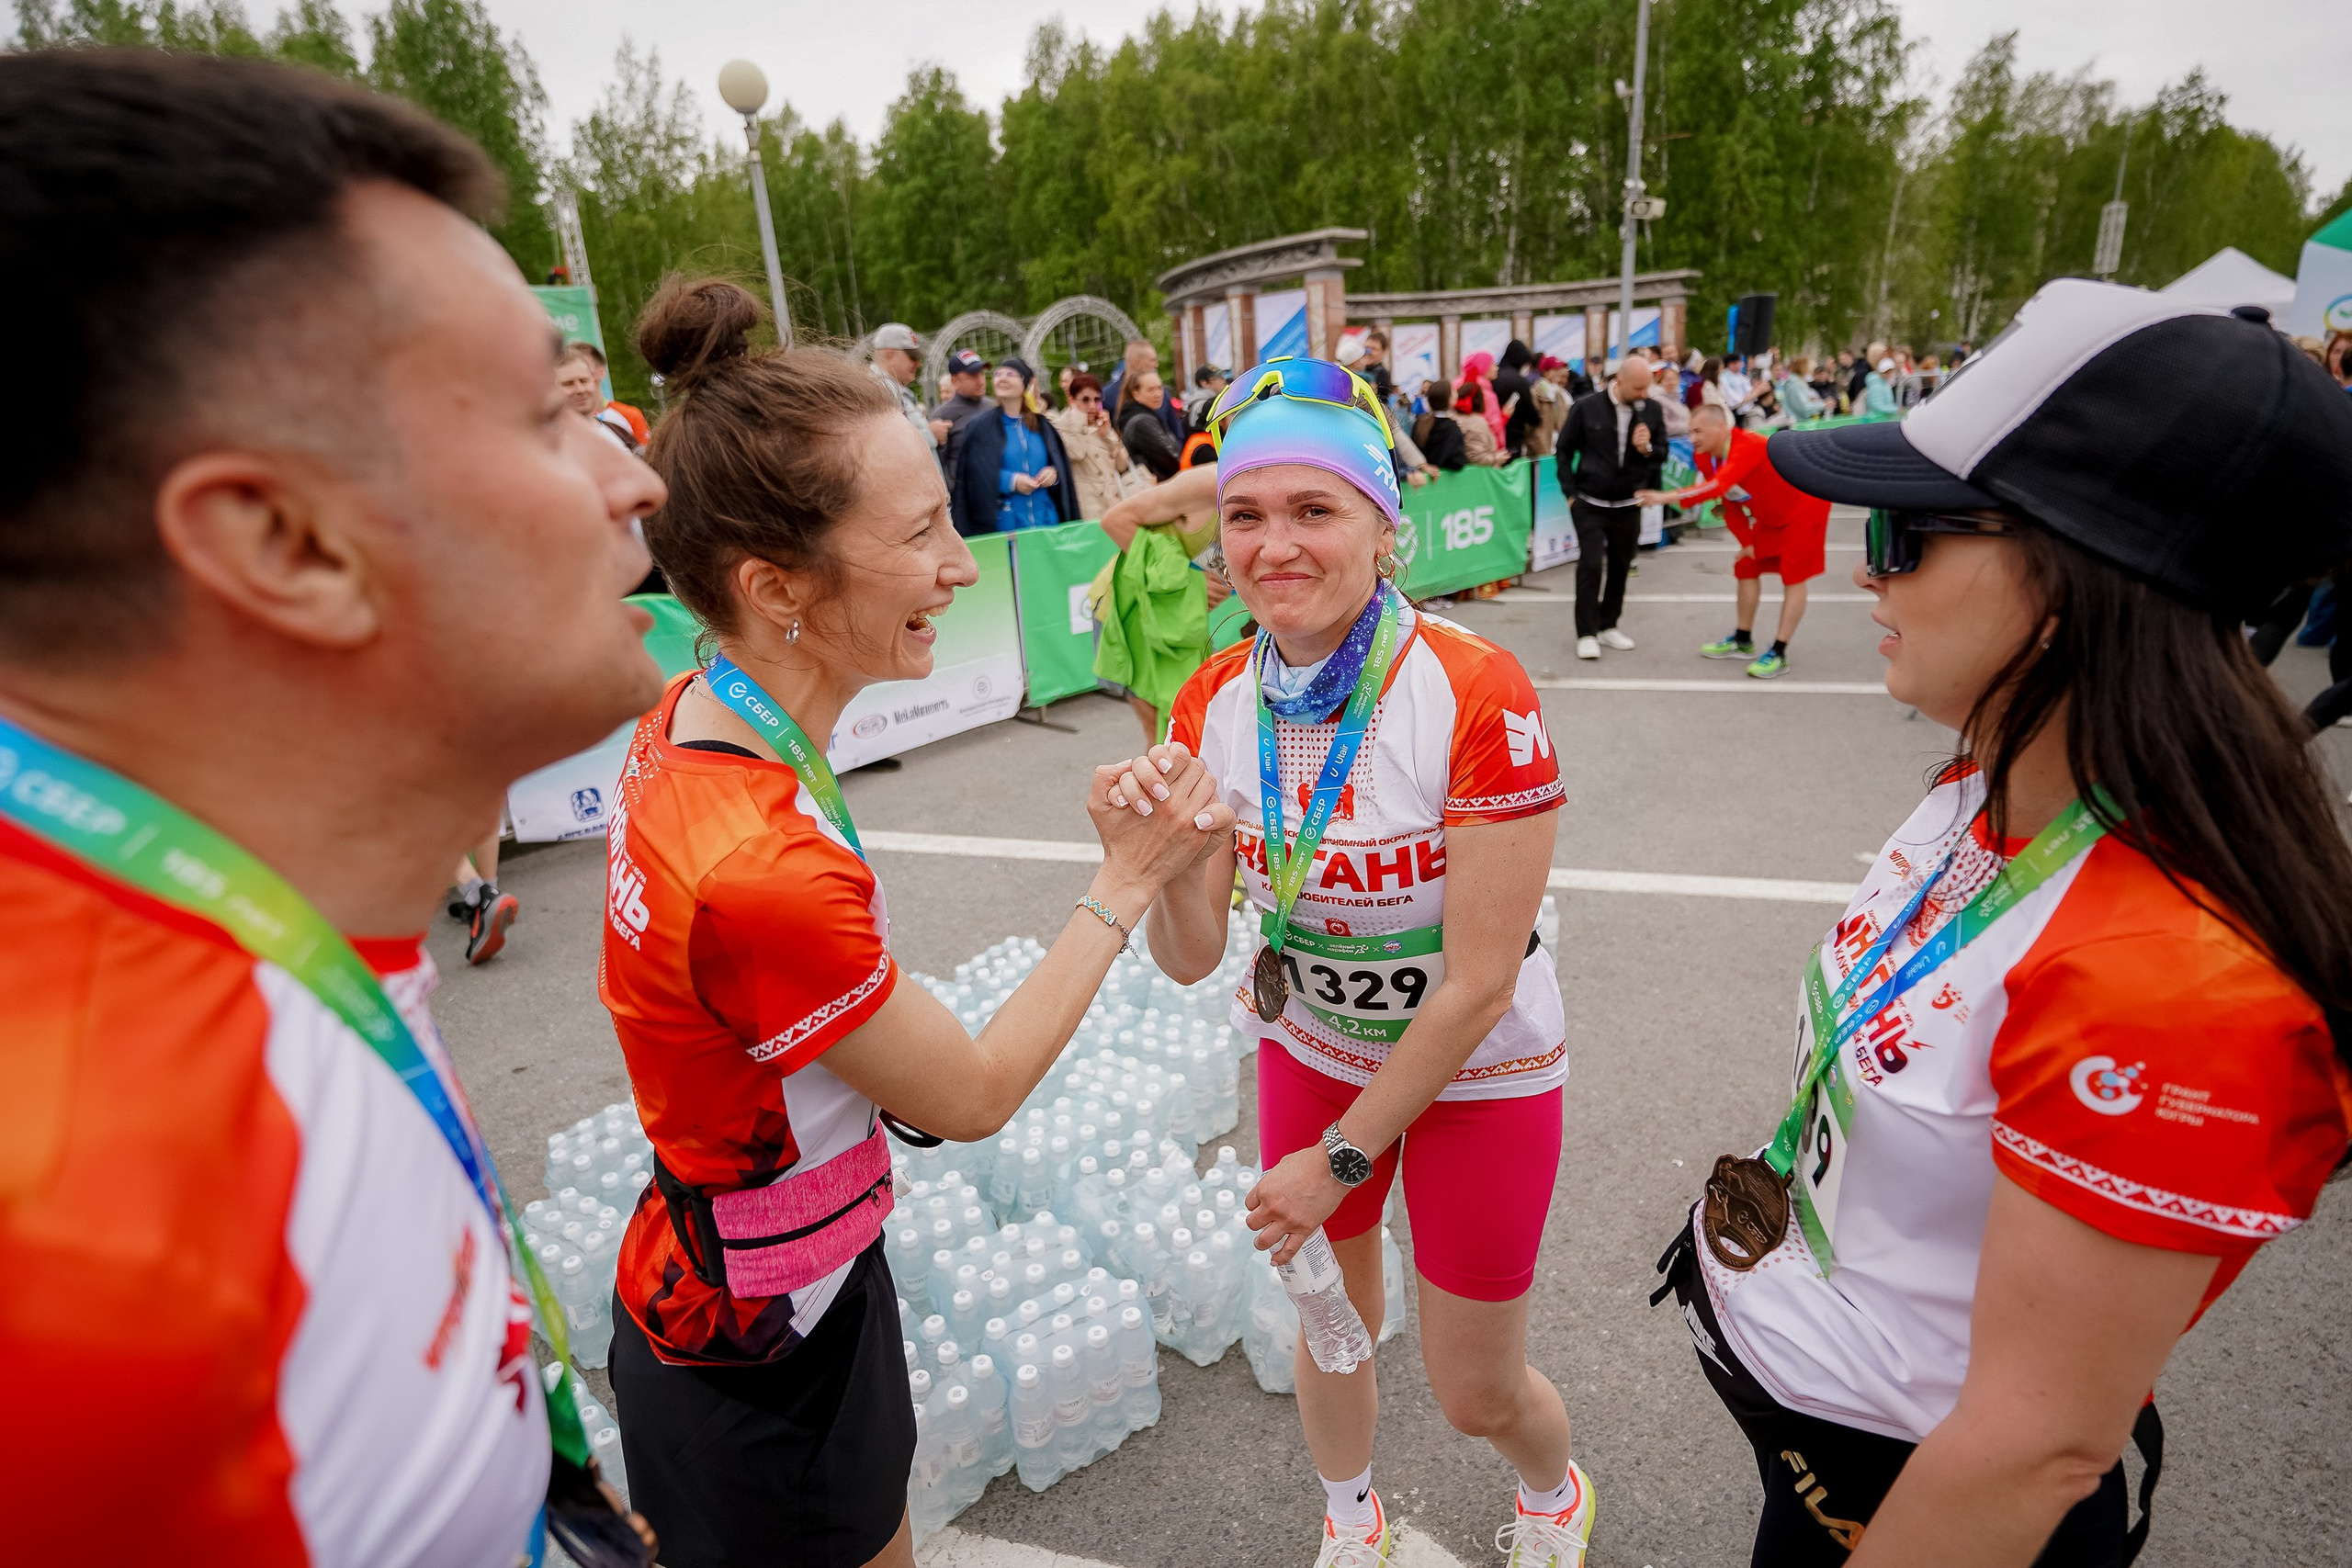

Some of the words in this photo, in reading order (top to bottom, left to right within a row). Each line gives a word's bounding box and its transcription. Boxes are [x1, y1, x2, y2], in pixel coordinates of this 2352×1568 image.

[1441, 506, 1494, 551] 185
[1374, 649, 1385, 669] 185
[744, 696, 779, 728] СБЕР
[786, 739, 807, 762] 185
[803, 763, 818, 783] лет
[1335, 744, 1349, 764] Utair
[1269, 811, 1278, 840] СБЕР
[1311, 798, 1327, 826] СБЕР
[1379, 831, 1415, 846] ОКРУГ
[2043, 829, 2071, 858] лет
[1272, 852, 1281, 870] 185
[1288, 870, 1298, 887] 185
[1296, 852, 1306, 869] лет
[1377, 895, 1414, 908] БЕГА
[613, 917, 640, 951] БЕГА
[1293, 935, 1316, 947] СБЕР
[1282, 953, 1429, 1011] 1329
[1845, 956, 1872, 991] СБЕР
[1329, 1014, 1362, 1037] 4,2
[1856, 1045, 1883, 1087] БЕГА
